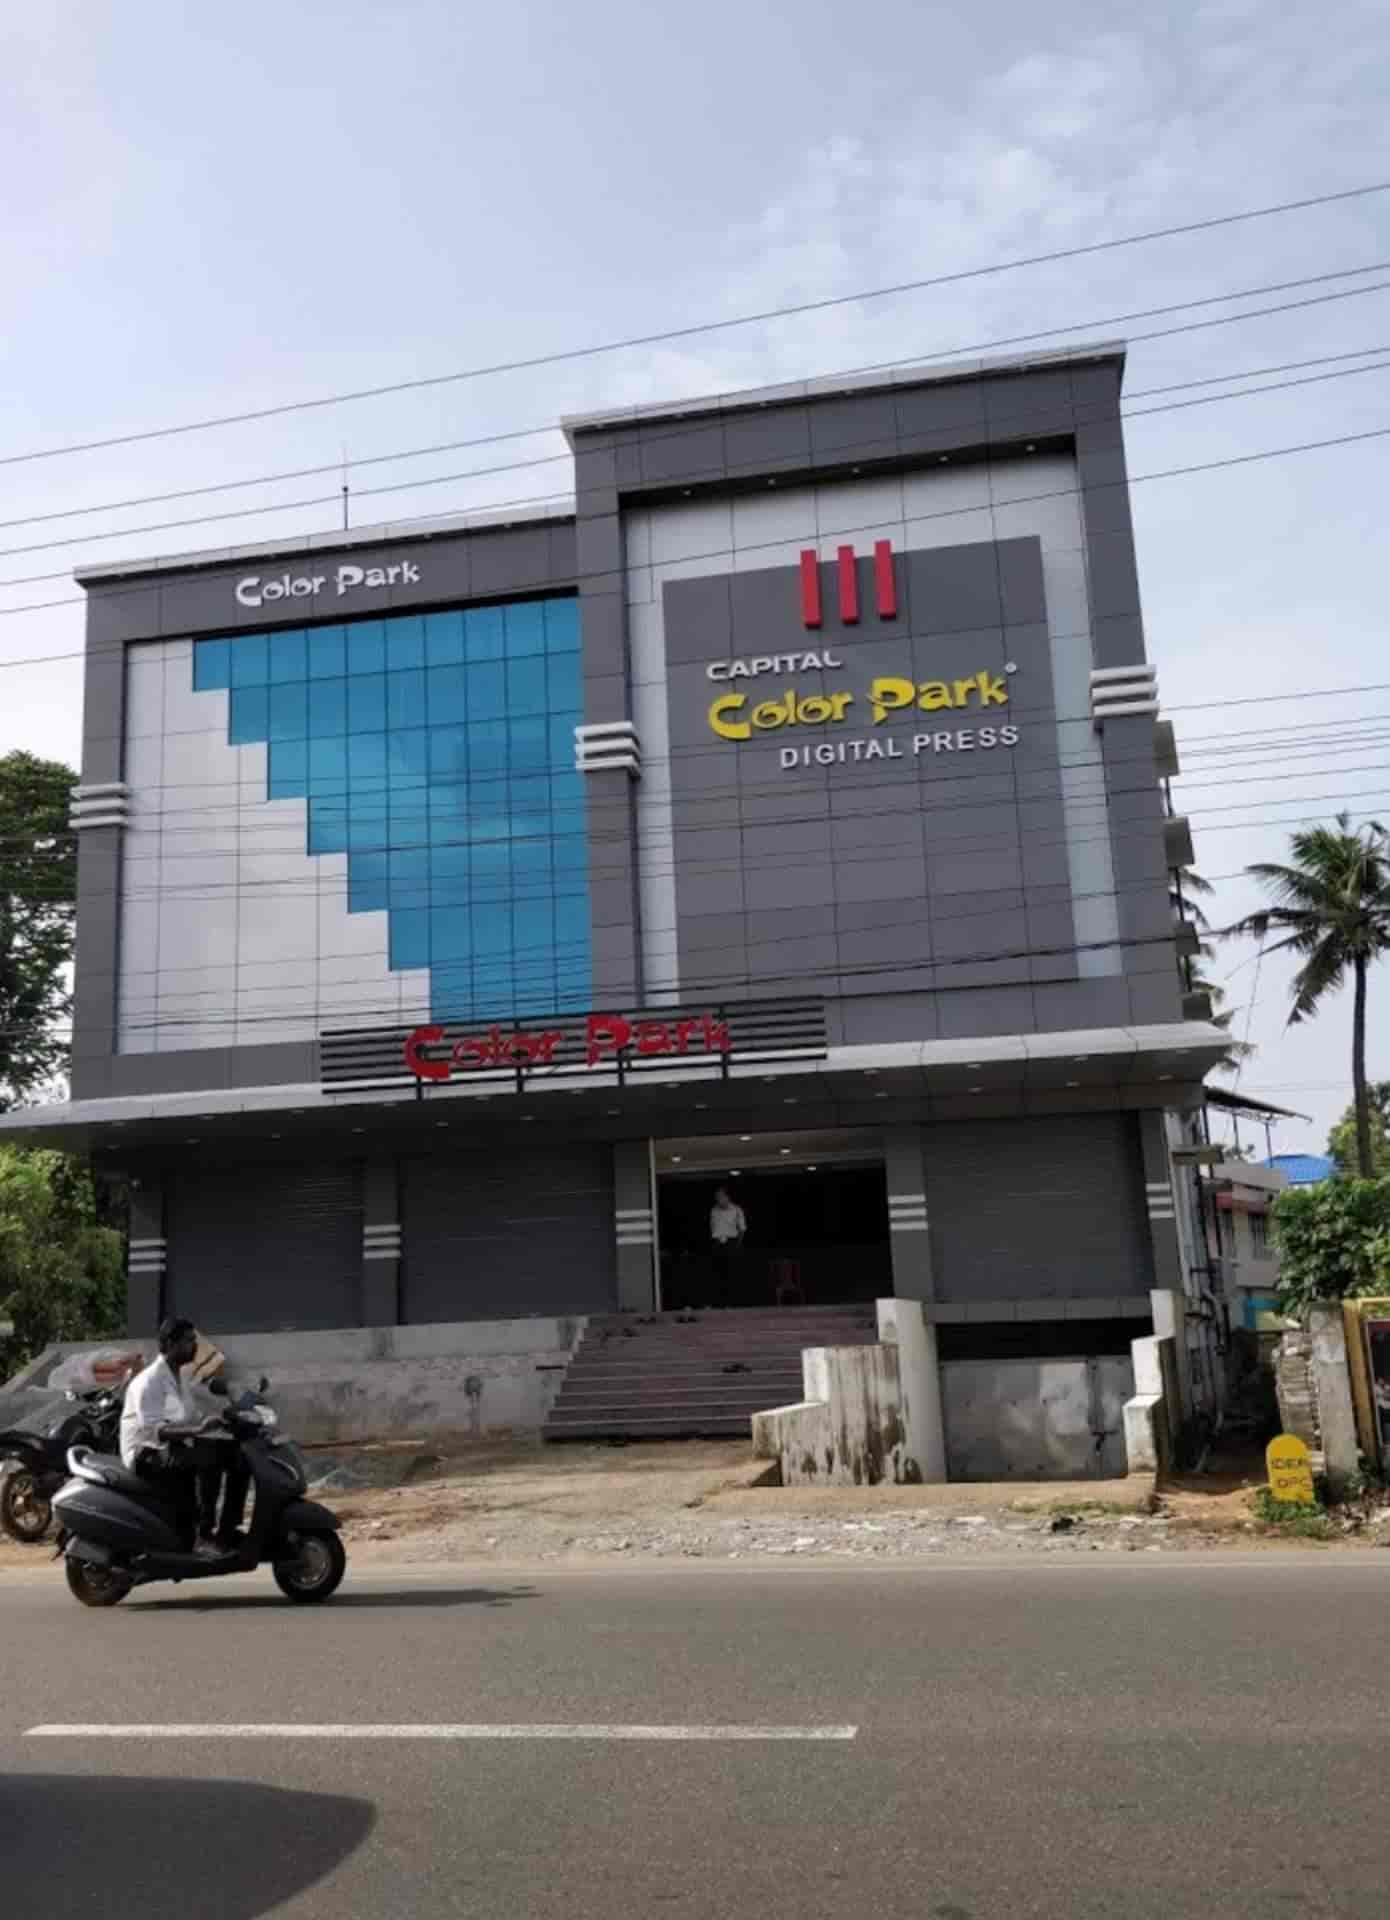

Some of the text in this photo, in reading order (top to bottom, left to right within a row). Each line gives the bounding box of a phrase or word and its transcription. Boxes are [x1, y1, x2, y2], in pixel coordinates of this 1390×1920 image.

[236, 560, 420, 606] Color Park
[706, 651, 842, 681] CAPITAL
[709, 671, 1010, 740] Color Park
[780, 726, 1020, 768] DIGITAL PRESS
[403, 1012, 734, 1079] Color Park
